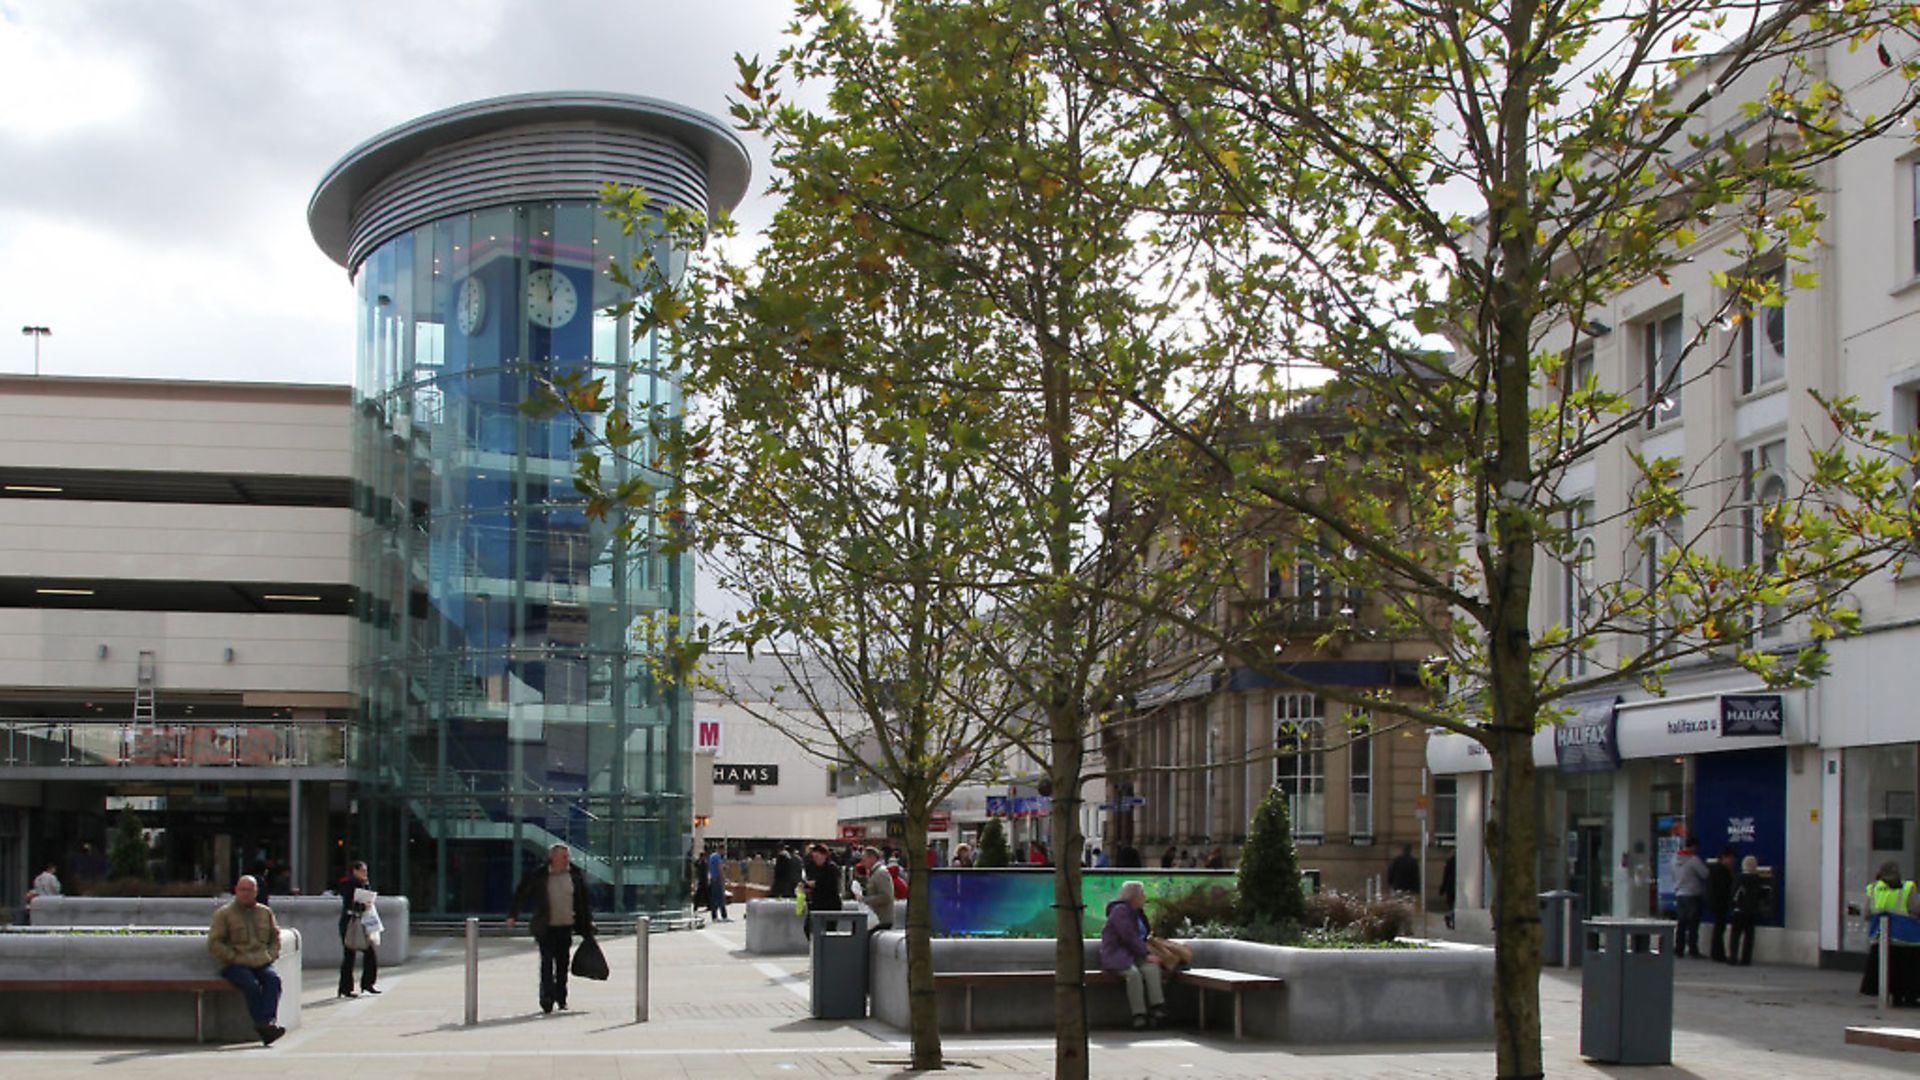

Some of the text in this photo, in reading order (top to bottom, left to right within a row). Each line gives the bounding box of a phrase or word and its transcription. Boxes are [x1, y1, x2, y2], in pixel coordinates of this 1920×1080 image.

[1727, 710, 1780, 721] HALIFAX
[699, 722, 719, 747] M
[1557, 724, 1608, 747] HALIFAX
[713, 768, 769, 781] HAMS
